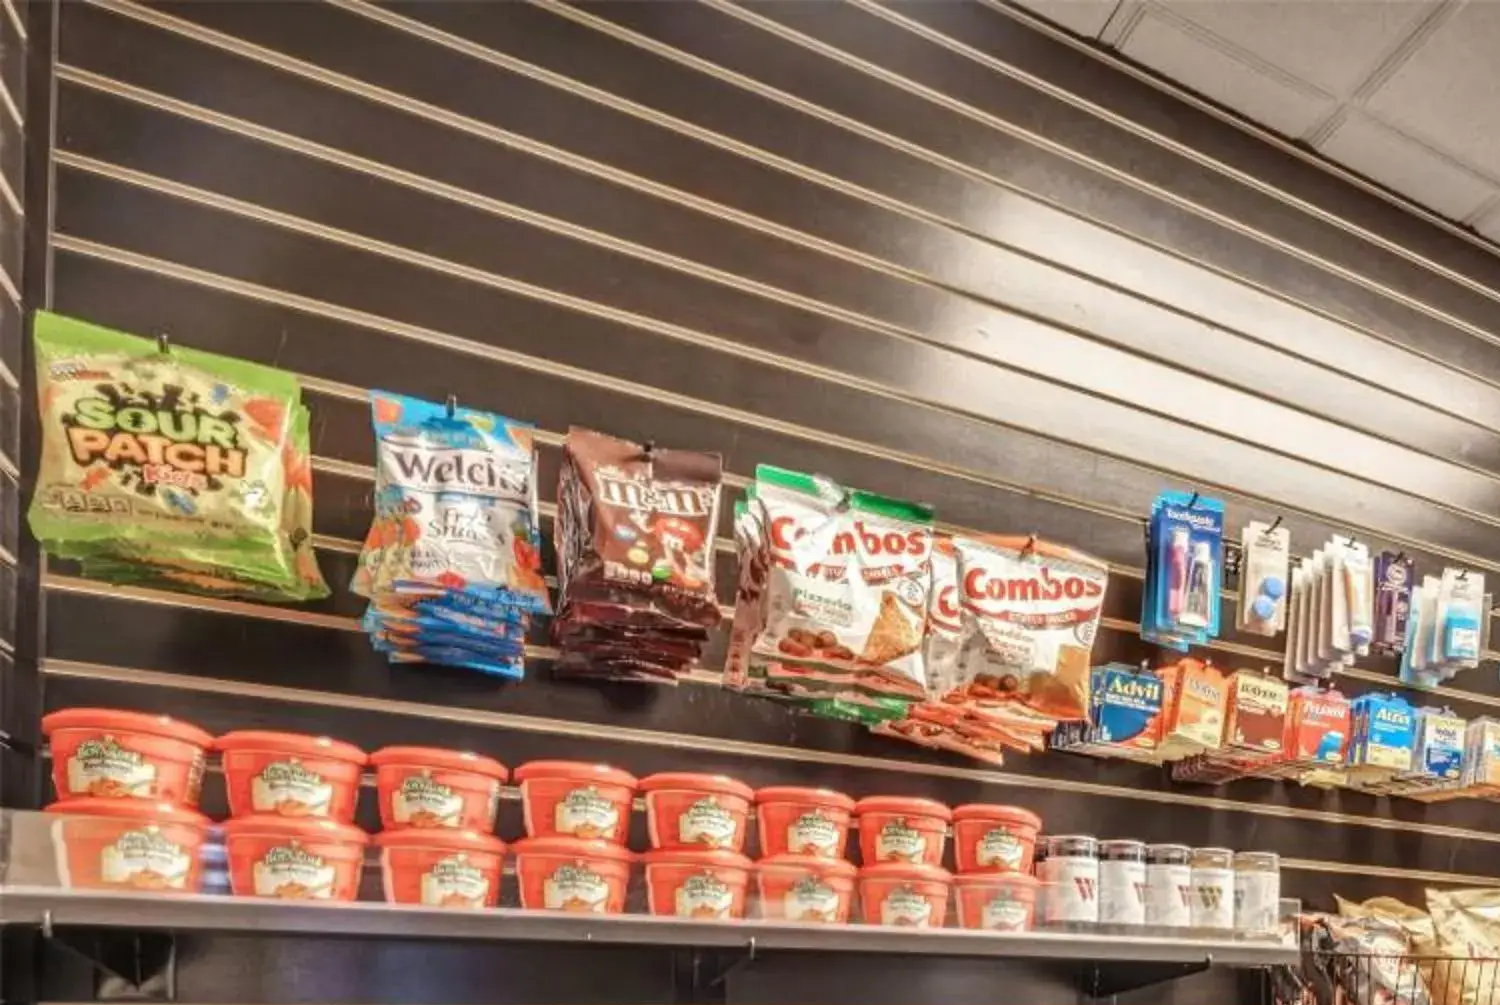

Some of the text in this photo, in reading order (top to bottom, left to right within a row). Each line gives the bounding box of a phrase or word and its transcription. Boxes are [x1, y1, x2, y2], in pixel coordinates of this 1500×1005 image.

[73, 396, 240, 450] SOUR
[66, 428, 248, 478] PATCH
[394, 451, 529, 494] Welc
[771, 516, 926, 555] Cmbos
[964, 565, 1103, 601] Combos
[1108, 675, 1160, 700] Advil
